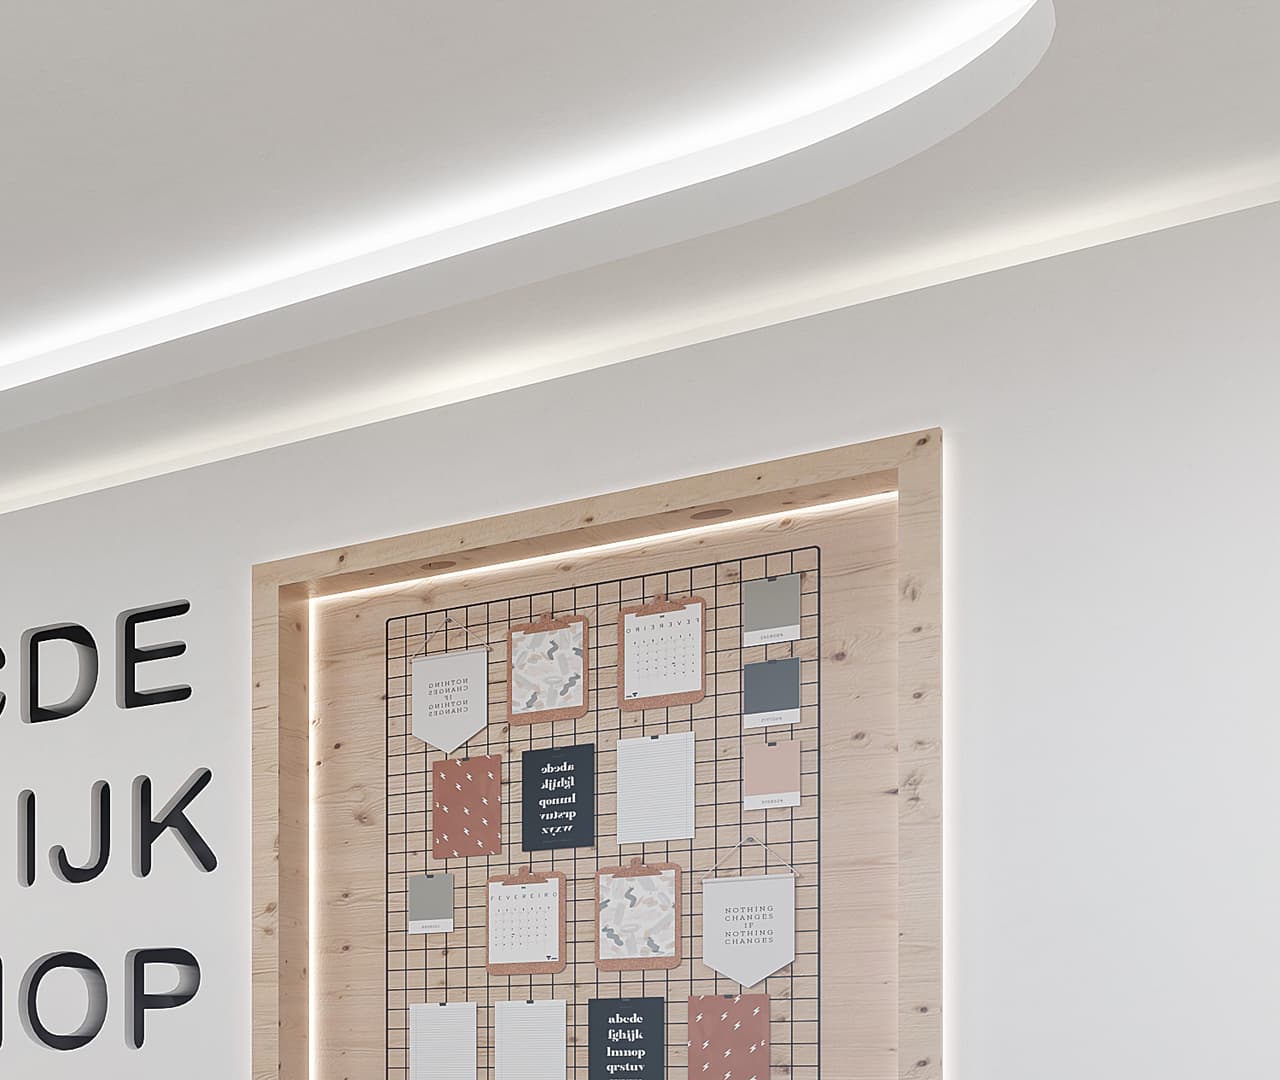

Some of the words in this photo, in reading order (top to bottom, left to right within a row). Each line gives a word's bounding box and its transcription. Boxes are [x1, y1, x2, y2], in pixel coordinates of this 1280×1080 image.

[725, 905, 774, 914] NOTHING
[725, 913, 774, 921] CHANGES
[725, 929, 774, 937] NOTHING
[725, 937, 774, 945] CHANGES
[608, 1012, 643, 1024] abcde
[608, 1029, 644, 1042] fghijk
[606, 1046, 646, 1059] lmnop
[606, 1063, 645, 1074] qrstuv
